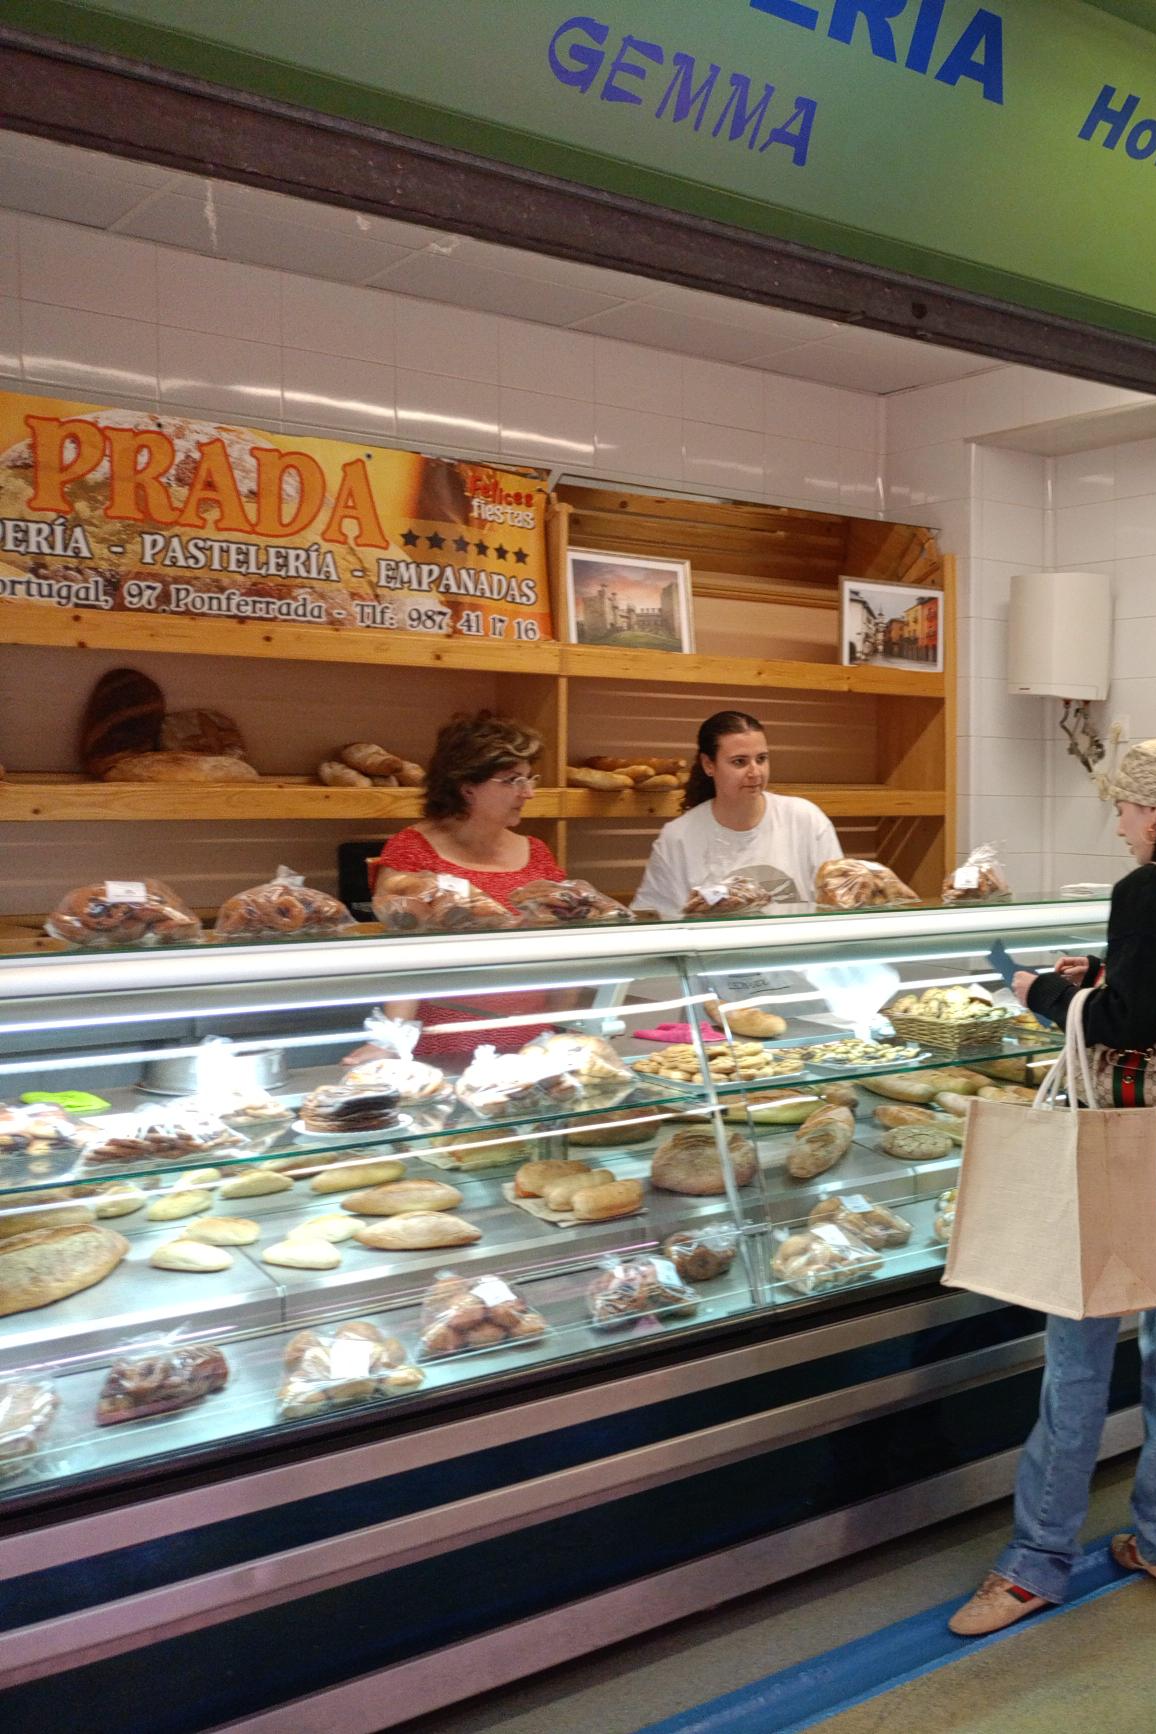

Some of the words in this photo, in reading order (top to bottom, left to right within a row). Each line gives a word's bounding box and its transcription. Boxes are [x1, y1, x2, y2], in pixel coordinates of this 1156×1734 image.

[548, 16, 818, 167] GEMMA
[750, 0, 1004, 106] RIA
[24, 413, 390, 550] PRADA
[471, 498, 536, 530] fiestas
[0, 515, 93, 559] ERÍA
[141, 532, 340, 583] PASTELERÍA
[376, 558, 537, 605] EMPANADAS
[171, 584, 325, 622] Ponferrada
[407, 607, 452, 631] 987
[458, 611, 483, 635] 41
[490, 616, 507, 639] 17
[514, 618, 538, 641] 16
